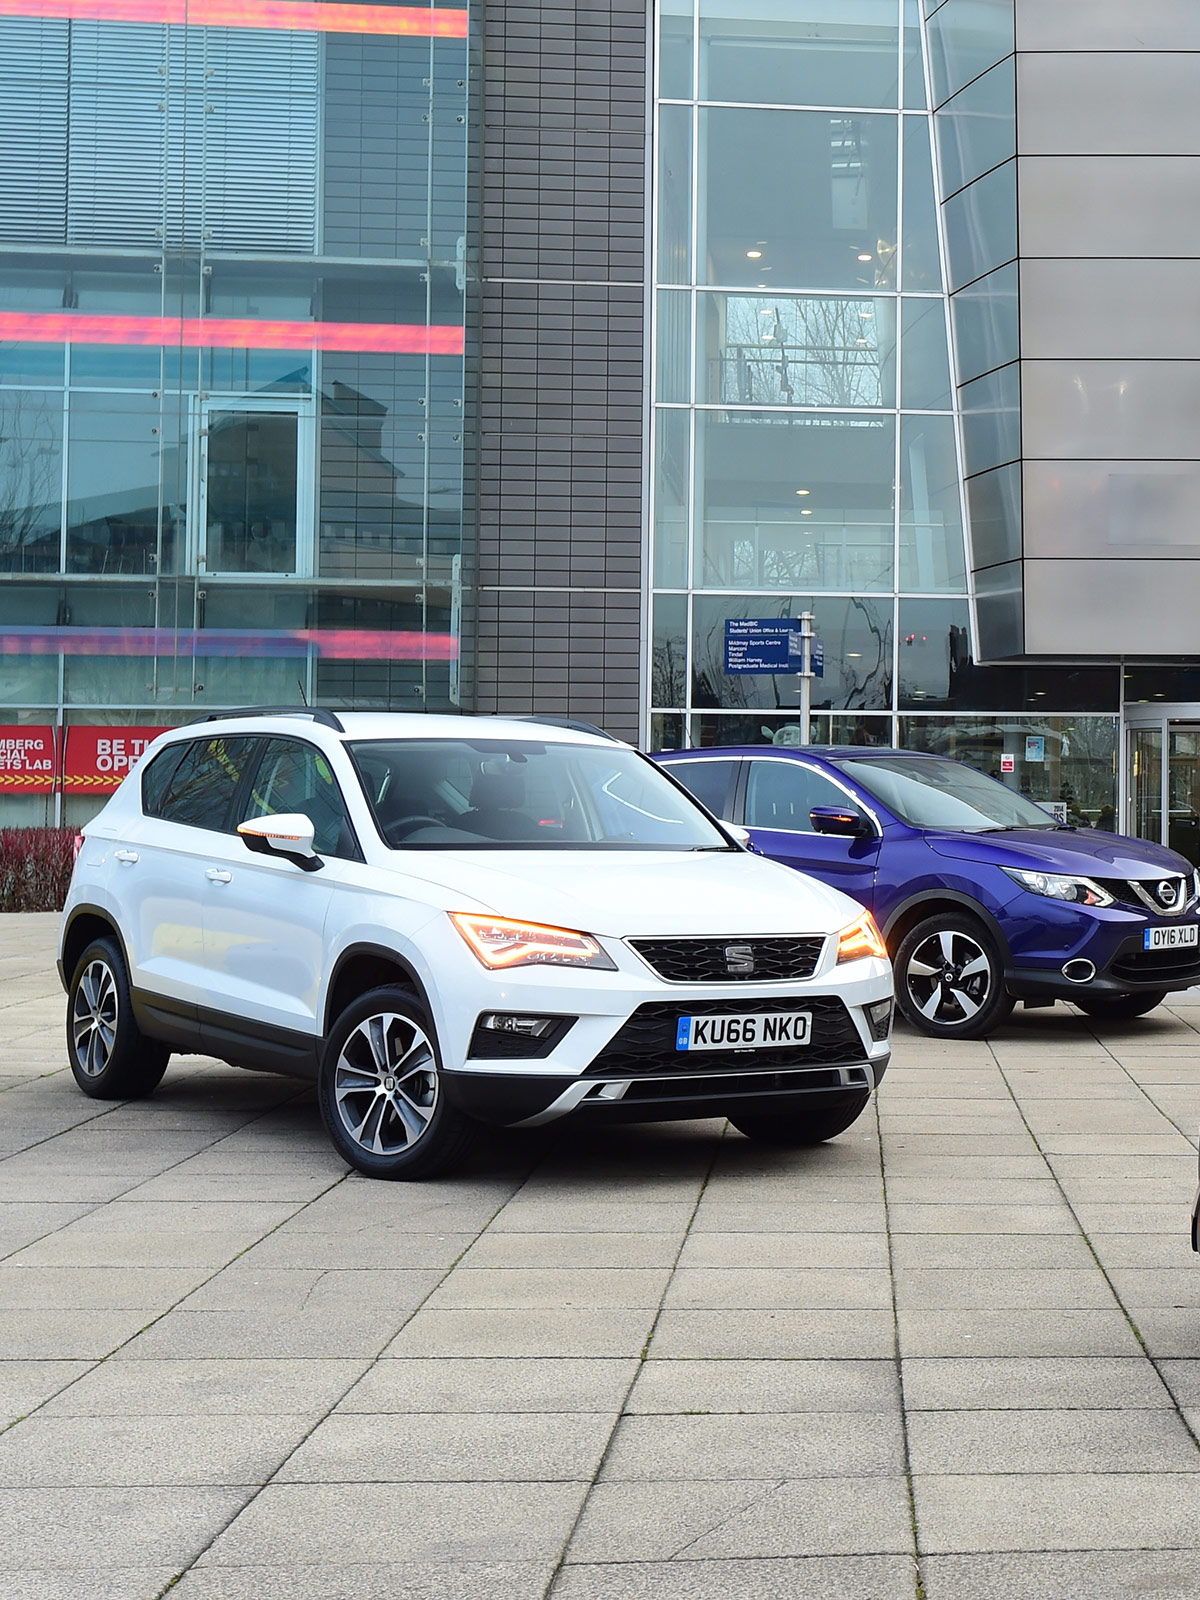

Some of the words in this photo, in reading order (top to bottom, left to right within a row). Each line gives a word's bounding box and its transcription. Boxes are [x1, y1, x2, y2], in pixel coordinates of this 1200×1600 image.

[97, 739, 126, 755] BE
[25, 759, 52, 770] LAB
[1153, 929, 1176, 946] OY16
[1178, 927, 1195, 944] XLD
[679, 1037, 688, 1045] GB
[693, 1018, 757, 1045] KU66
[763, 1016, 807, 1042] NKO
